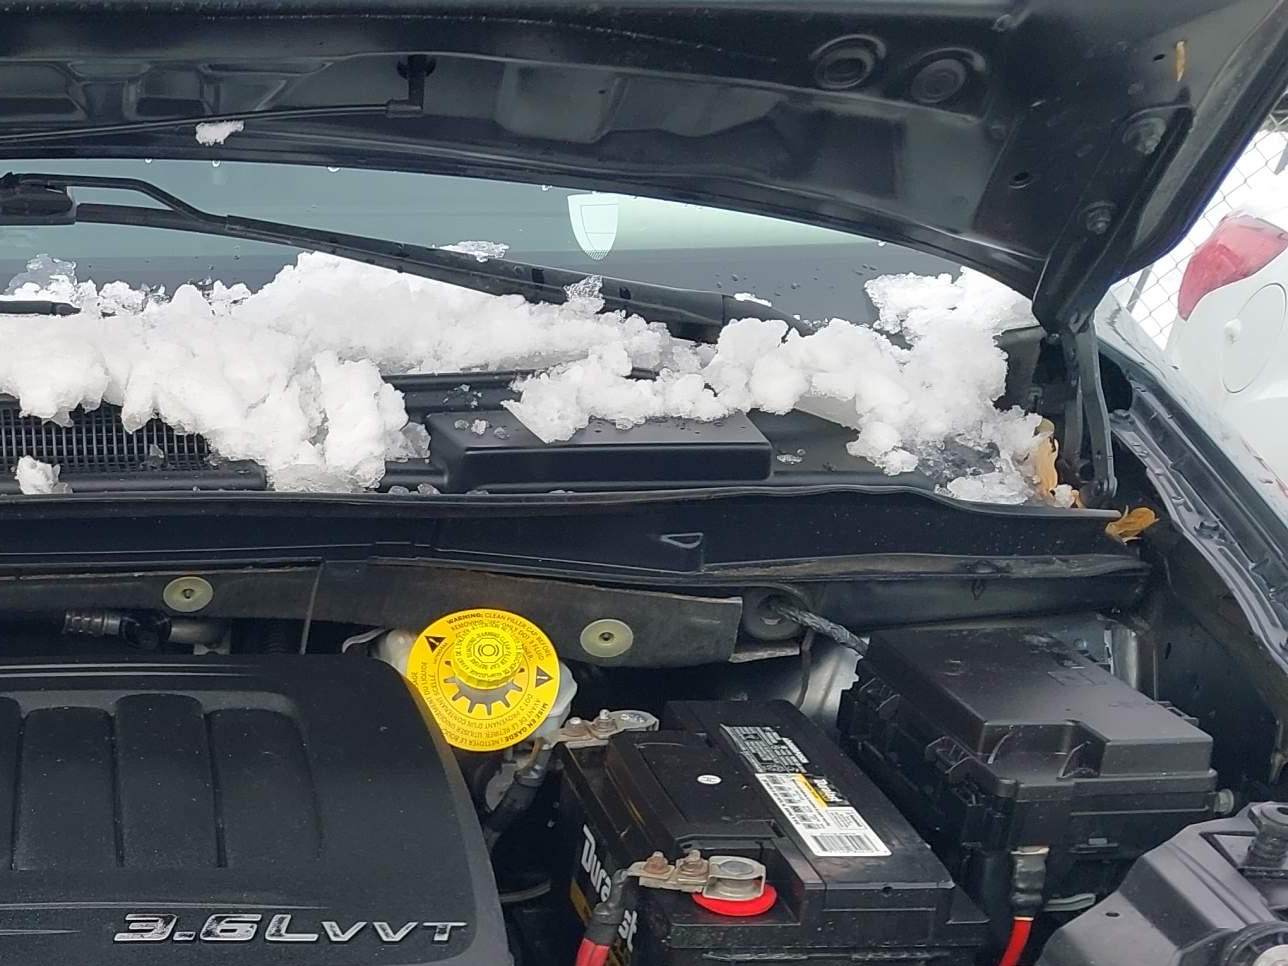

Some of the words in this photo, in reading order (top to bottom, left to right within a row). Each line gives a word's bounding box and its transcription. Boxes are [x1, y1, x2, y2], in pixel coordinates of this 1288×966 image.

[447, 612, 481, 625] WARNING:
[506, 616, 526, 628] FILLER
[525, 625, 537, 636] CAP
[535, 635, 552, 656] BEFORE
[517, 629, 530, 640] DOT
[531, 642, 545, 661] FLUID
[526, 718, 537, 728] EN
[533, 701, 549, 720] MISE
[503, 726, 528, 742] GARDE
[581, 824, 639, 953] Durast
[113, 913, 319, 942] 3.6L
[321, 921, 468, 942] VVT
